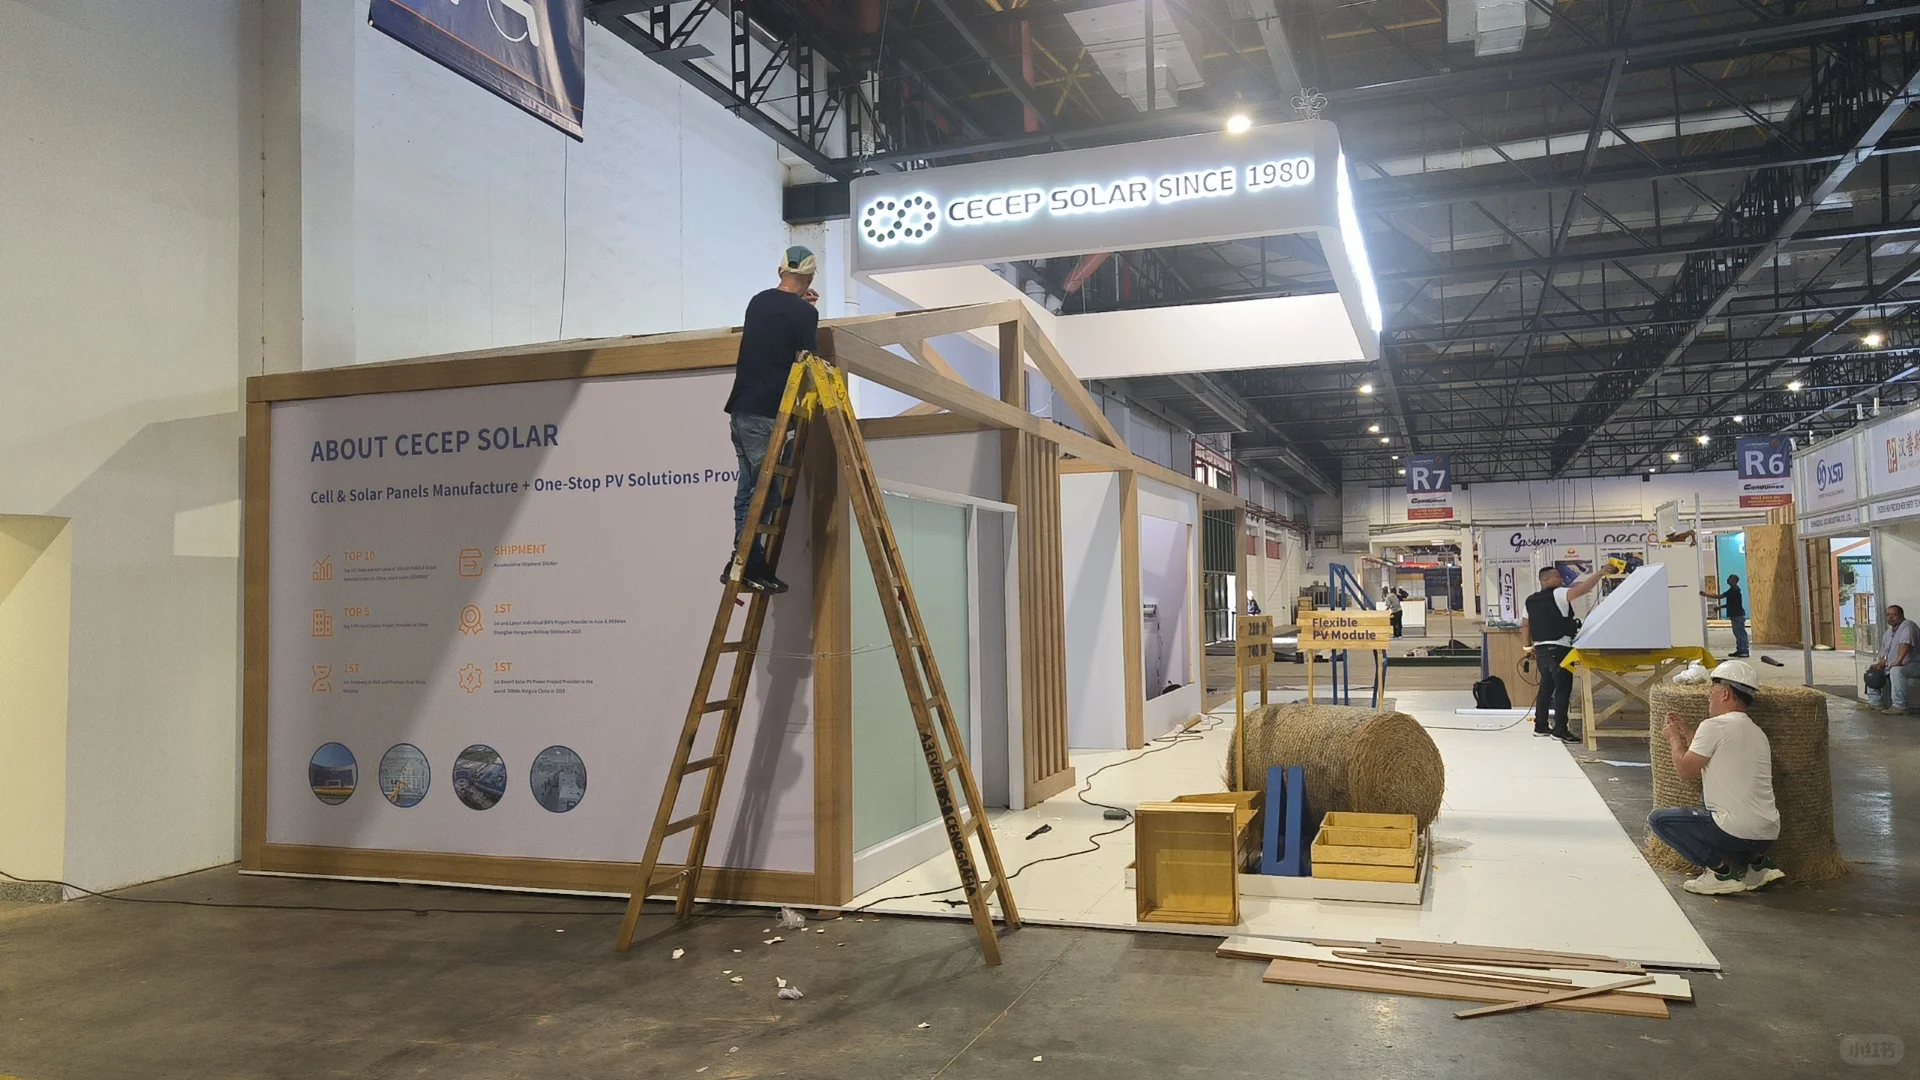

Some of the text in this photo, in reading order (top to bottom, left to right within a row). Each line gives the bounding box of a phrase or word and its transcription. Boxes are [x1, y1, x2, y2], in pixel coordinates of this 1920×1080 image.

[948, 159, 1310, 221] CECEP SOLAR SINCE 1980
[310, 423, 558, 463] ABOUT CECEP SOLAR
[1745, 451, 1784, 476] R6
[1412, 467, 1446, 490] R7
[310, 469, 740, 504] Cell & Solar Panels Manufacture + One-Stop PV Solutions Prov
[344, 550, 375, 561] TOP 10
[494, 544, 547, 556] SHIPMENT
[1504, 573, 1512, 611] China
[344, 607, 370, 617] TOP 5
[494, 603, 512, 614] 1ST
[1312, 617, 1358, 628] Flexible
[1313, 630, 1376, 640] PV Module
[344, 663, 359, 673] 1ST
[494, 662, 512, 672] 1ST
